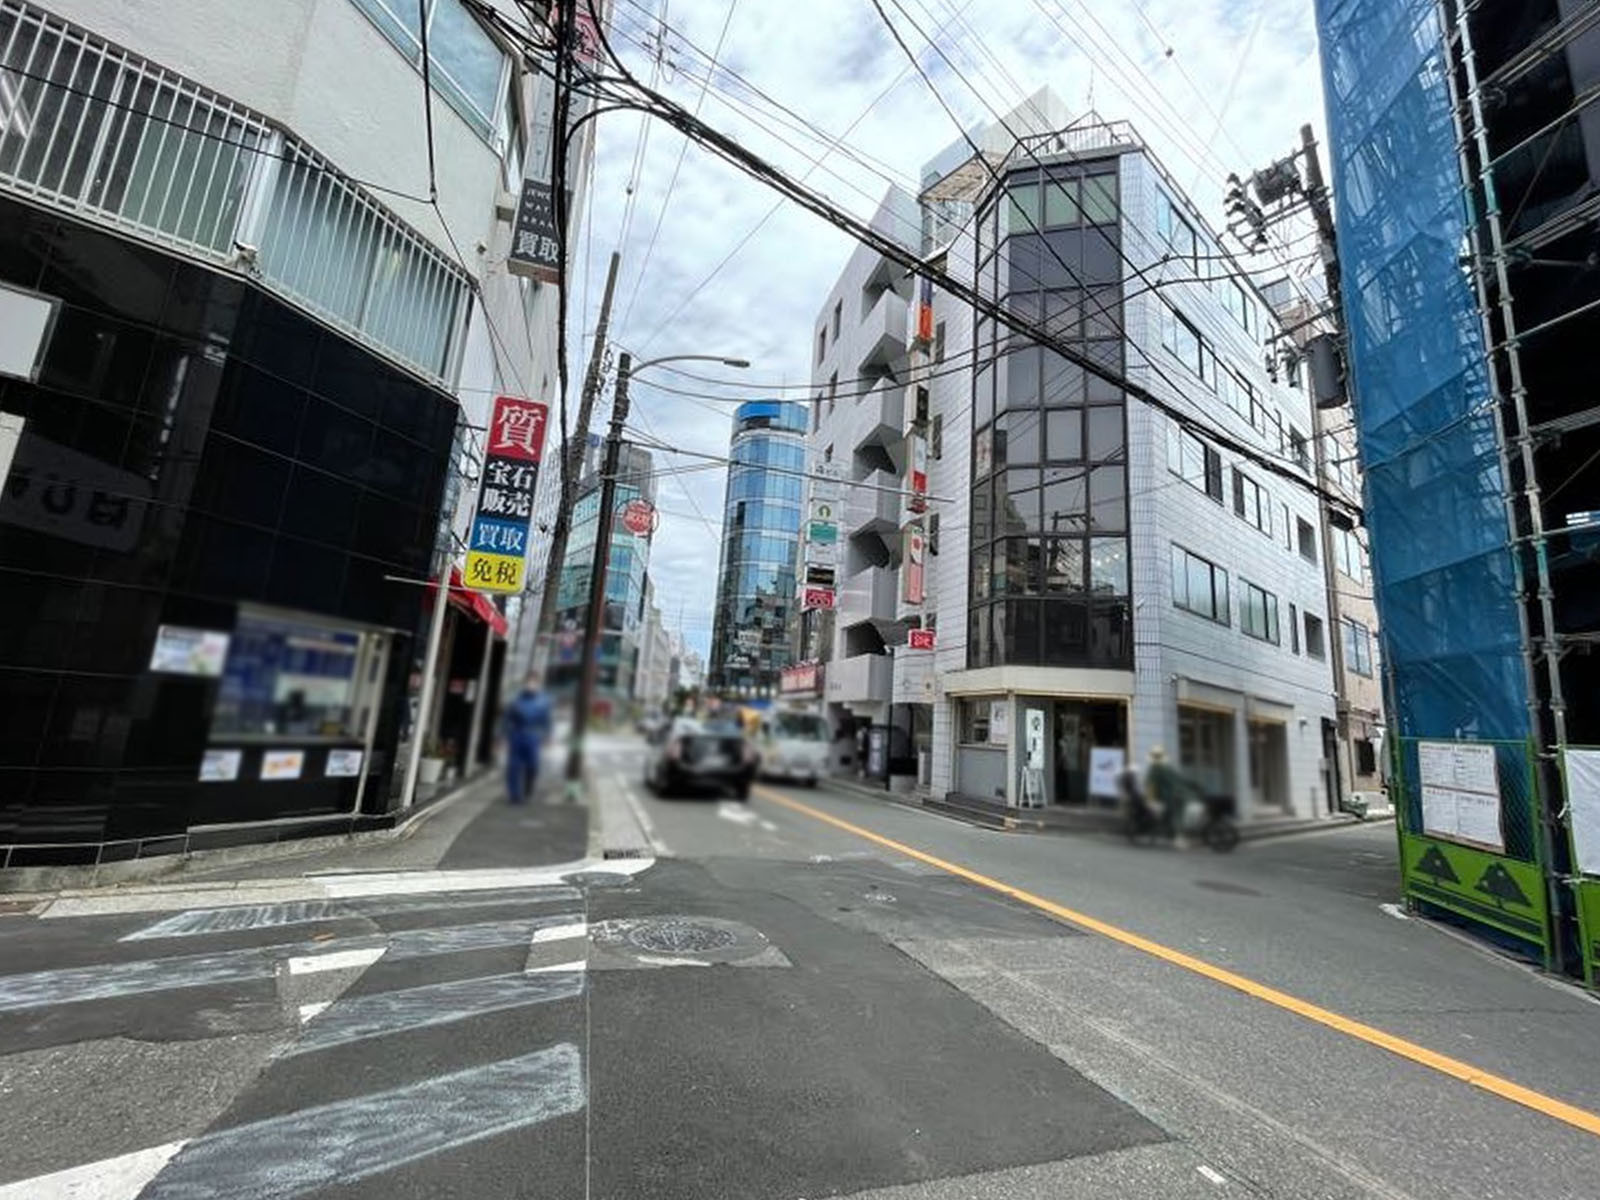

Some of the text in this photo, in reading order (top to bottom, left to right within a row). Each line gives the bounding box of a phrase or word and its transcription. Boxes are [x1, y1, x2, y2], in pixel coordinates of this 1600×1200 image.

[515, 230, 559, 263] 買取
[494, 406, 544, 454] 質
[487, 461, 536, 489] 宝石
[481, 489, 531, 517] 販売
[477, 523, 523, 551] 買取
[472, 558, 518, 585] 免税
